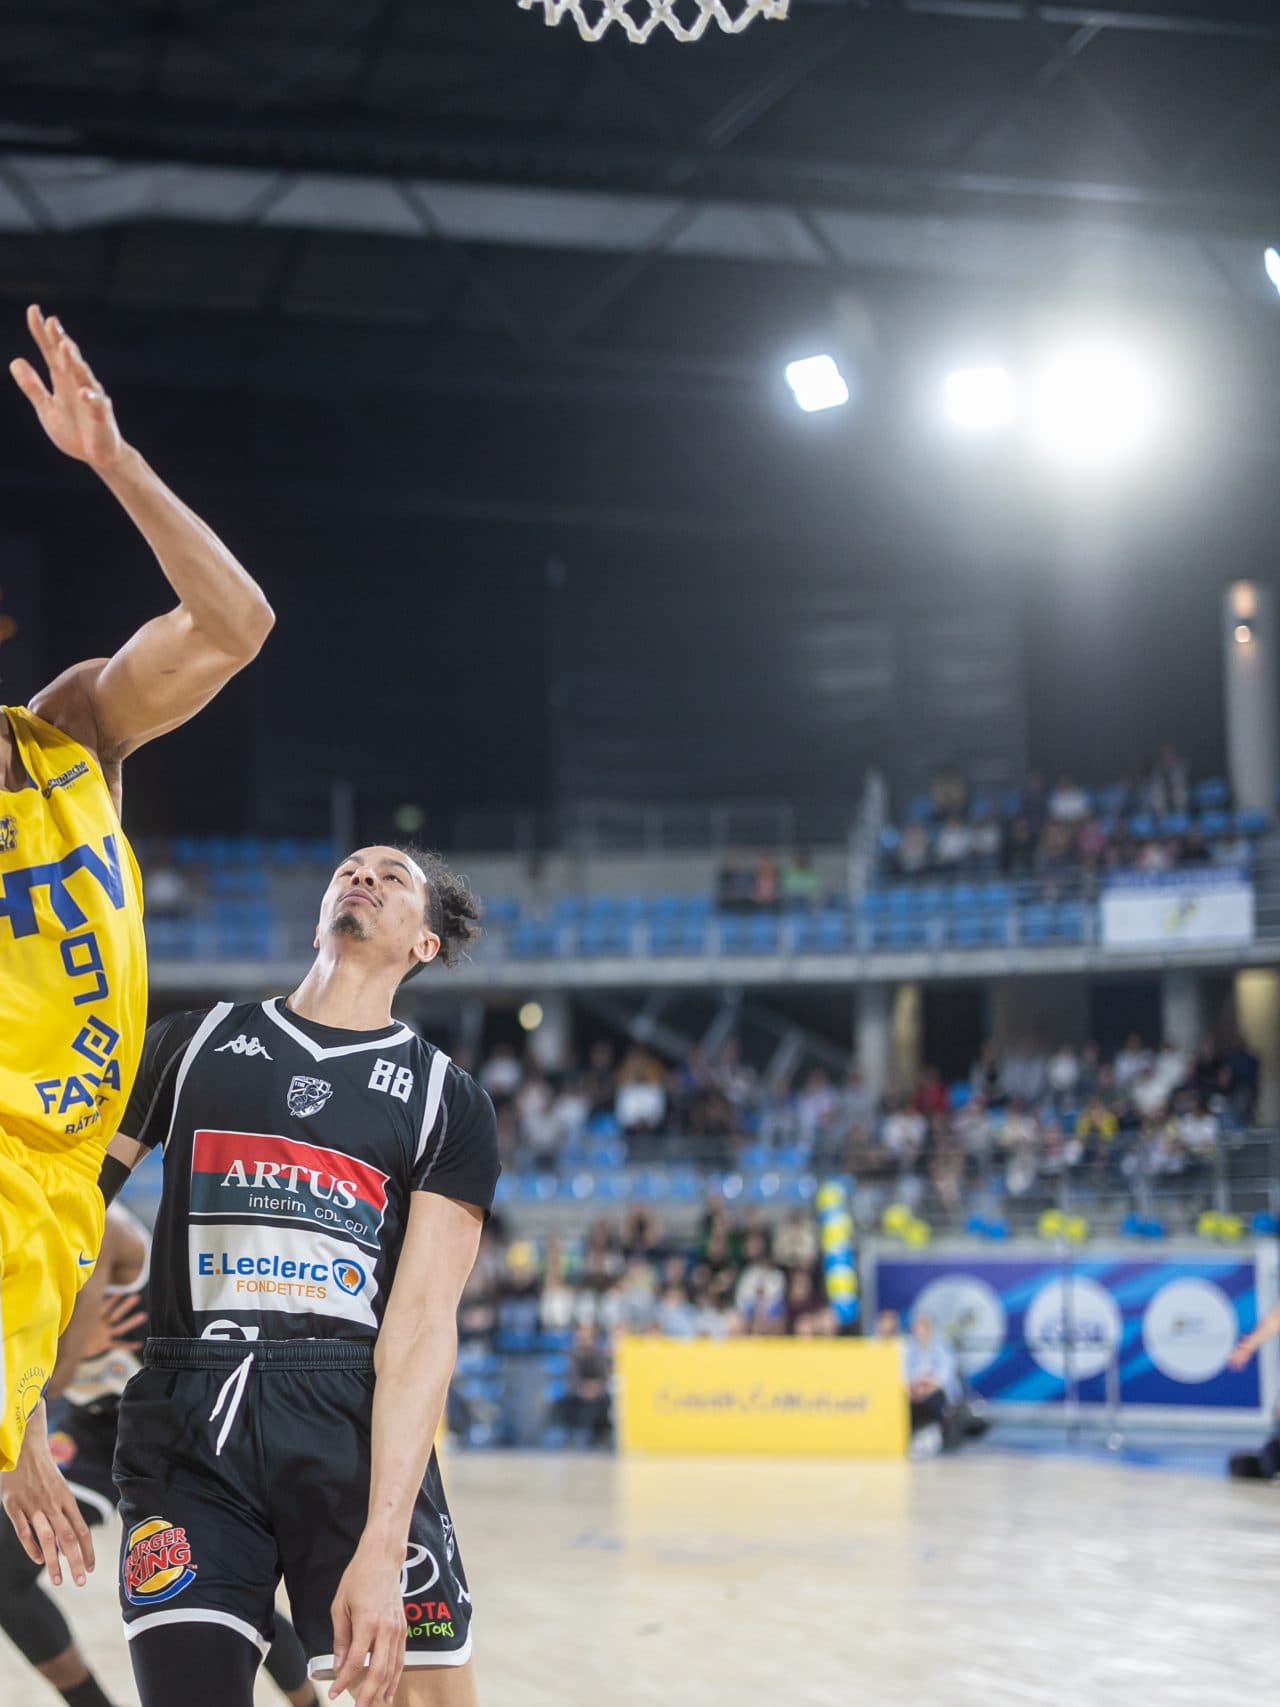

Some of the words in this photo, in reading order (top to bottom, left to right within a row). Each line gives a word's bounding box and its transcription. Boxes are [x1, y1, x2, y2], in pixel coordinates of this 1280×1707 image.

[60, 931, 109, 1006] 9
[367, 1057, 414, 1103] 88
[220, 1159, 358, 1210] ARTUS
[249, 1193, 307, 1213] interim
[344, 1219, 369, 1236] CDI
[198, 1252, 329, 1282] E.Leclerc
[236, 1279, 328, 1299] FONDETTES
[126, 1541, 192, 1597] KING
[404, 1601, 452, 1621] OTA
